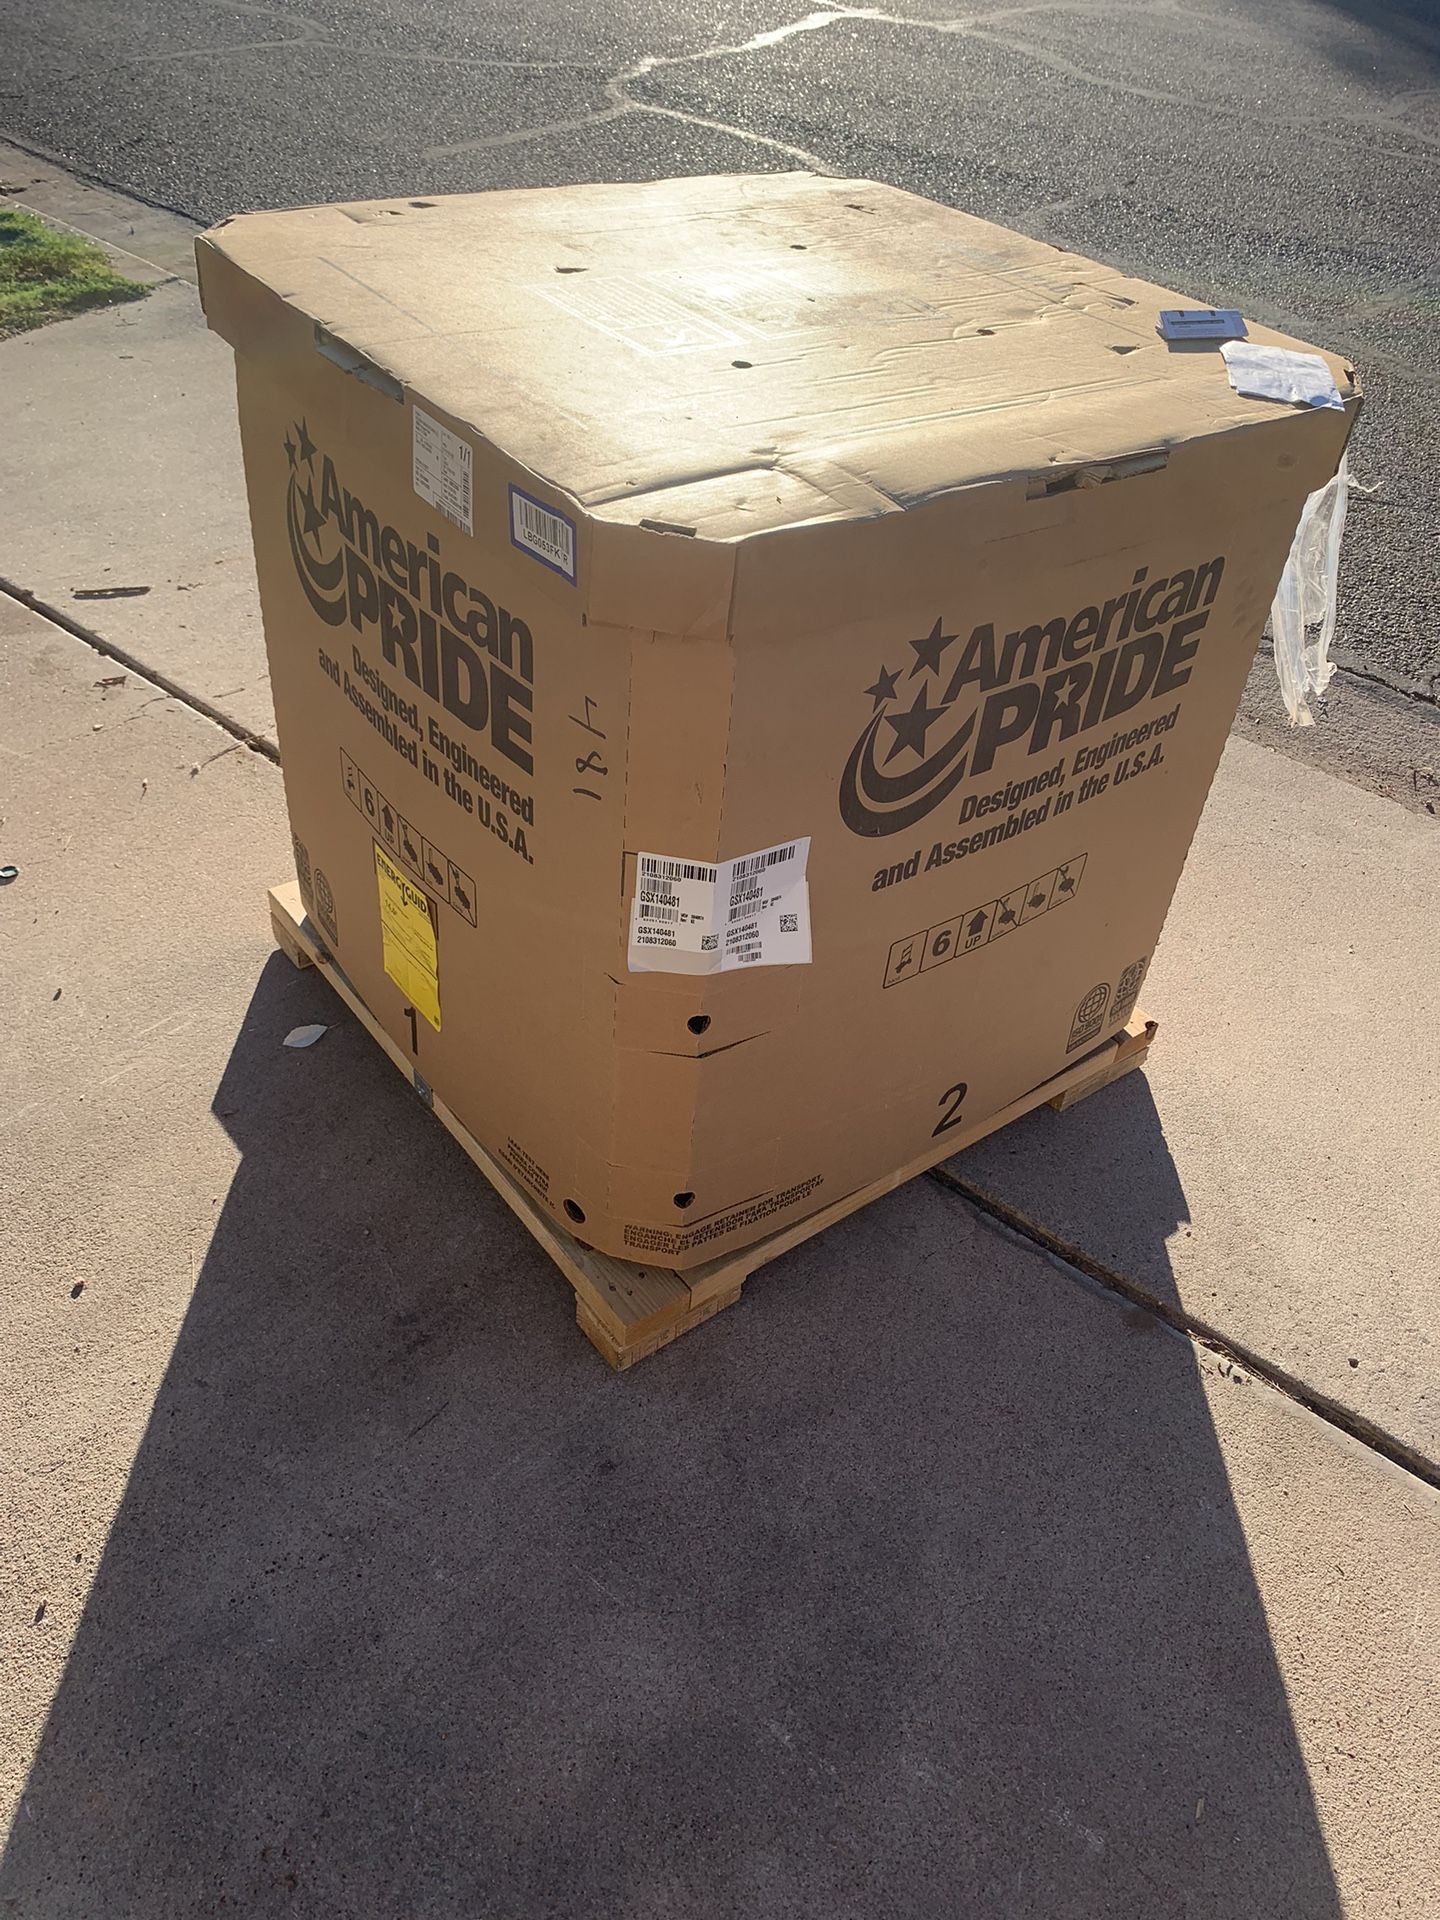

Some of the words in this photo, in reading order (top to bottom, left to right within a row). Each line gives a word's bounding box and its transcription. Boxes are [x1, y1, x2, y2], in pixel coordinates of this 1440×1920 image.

[459, 446, 471, 469] 1/1
[321, 454, 534, 684] American
[940, 555, 1226, 705] American
[345, 545, 534, 777] PRIDE
[969, 610, 1209, 777] PRIDE
[352, 644, 424, 742] Designed,
[428, 716, 534, 827] Engineered
[318, 648, 341, 687] and
[343, 671, 418, 768] Assembled
[422, 749, 439, 786] in
[443, 766, 473, 814] the
[478, 796, 534, 865] U.S.A.
[959, 758, 1065, 825] Designed,
[1072, 703, 1182, 776] Engineered
[364, 788, 375, 816] 6
[872, 849, 921, 892] and
[924, 797, 1051, 872] Assembled
[1053, 790, 1074, 816] in
[1078, 771, 1110, 804] the
[1113, 743, 1164, 786] U.S.A.
[640, 891, 680, 907] GSX140481
[729, 887, 763, 907] GSX140481
[637, 936, 677, 947] 2108312060
[638, 926, 675, 937] GSX140481
[725, 930, 759, 946] 2108312060
[726, 922, 757, 938] GSX140481
[932, 930, 952, 957] 6
[965, 935, 981, 949] UP
[404, 1007, 418, 1055] 1
[931, 1083, 968, 1138] 2
[624, 1224, 672, 1238] WARNING:
[676, 1223, 712, 1239] ENGAGE
[714, 1205, 756, 1226] RETAINER
[758, 1197, 774, 1208] FOR
[776, 1174, 822, 1199] TRANSPORT
[624, 1234, 669, 1249] ENGAGER
[692, 1231, 725, 1248] PATTES
[726, 1225, 738, 1233] DE
[740, 1207, 777, 1228] FIXATION
[780, 1196, 803, 1209] POUR
[624, 1229, 677, 1245] ENGANCHE
[693, 1215, 744, 1240] RETENEDOR
[624, 1240, 680, 1256] TRANSPORT
